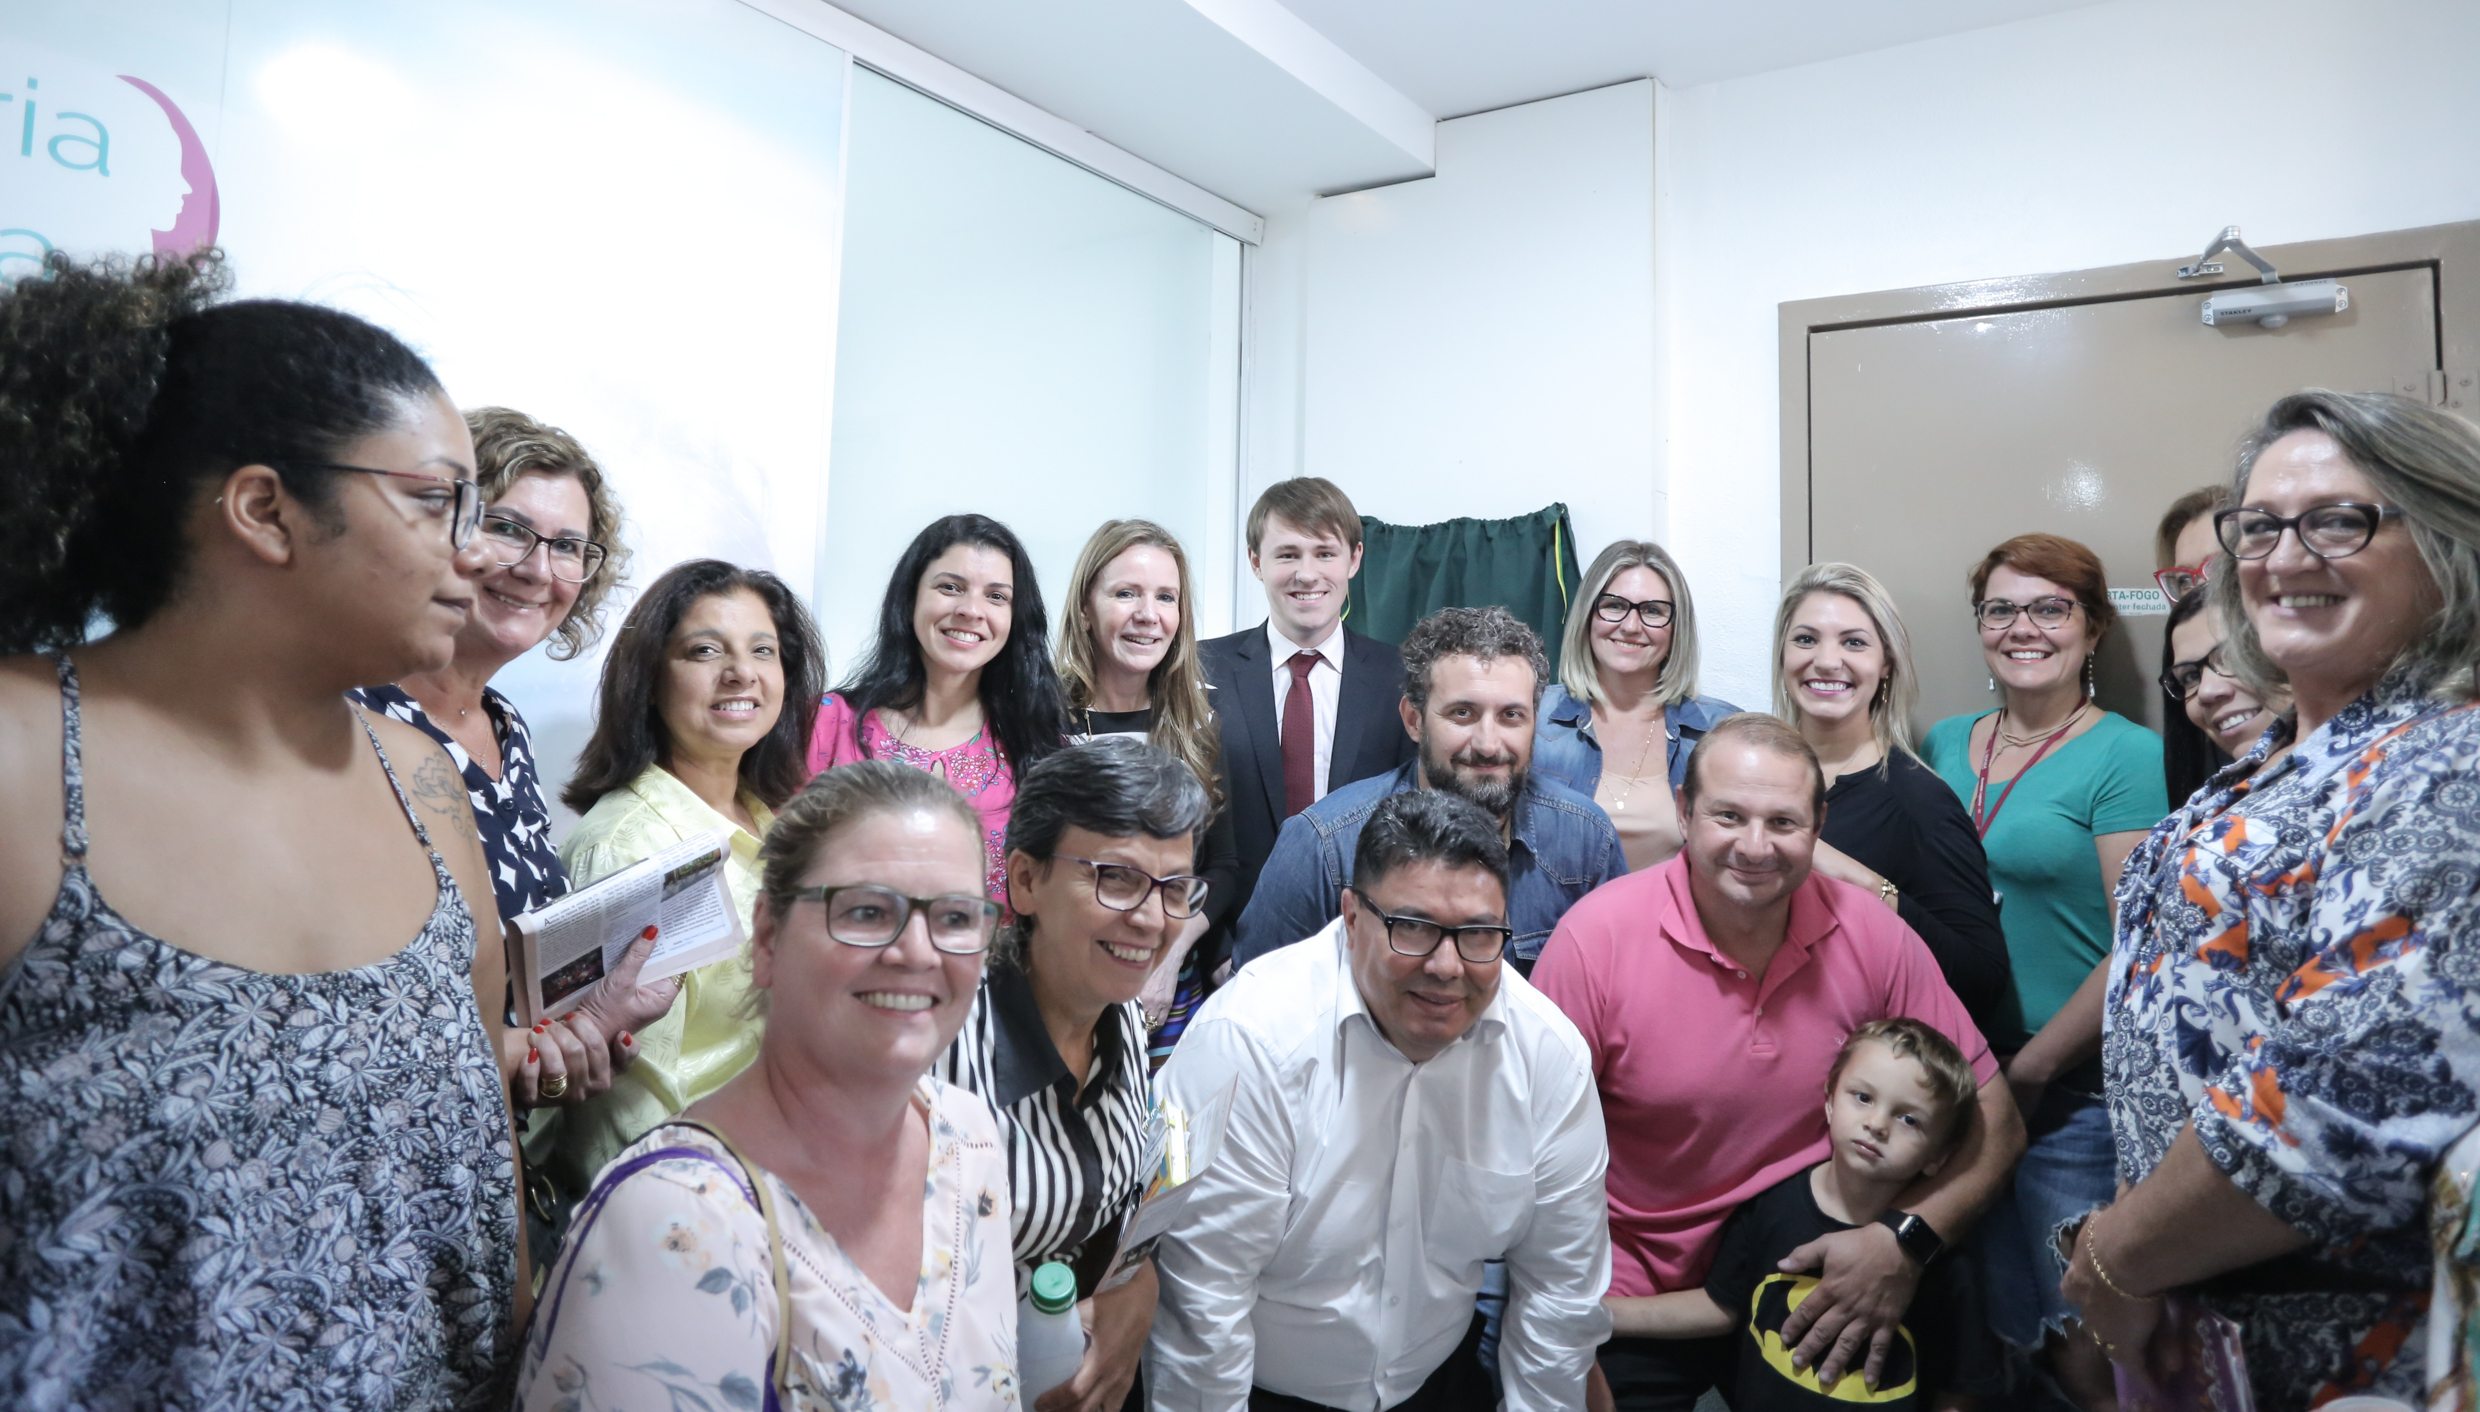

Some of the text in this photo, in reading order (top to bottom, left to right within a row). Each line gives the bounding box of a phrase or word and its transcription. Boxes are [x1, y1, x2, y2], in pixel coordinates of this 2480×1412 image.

[0, 76, 110, 177] ia
[2220, 308, 2252, 316] STANLEY
[2132, 602, 2167, 610] fechada
